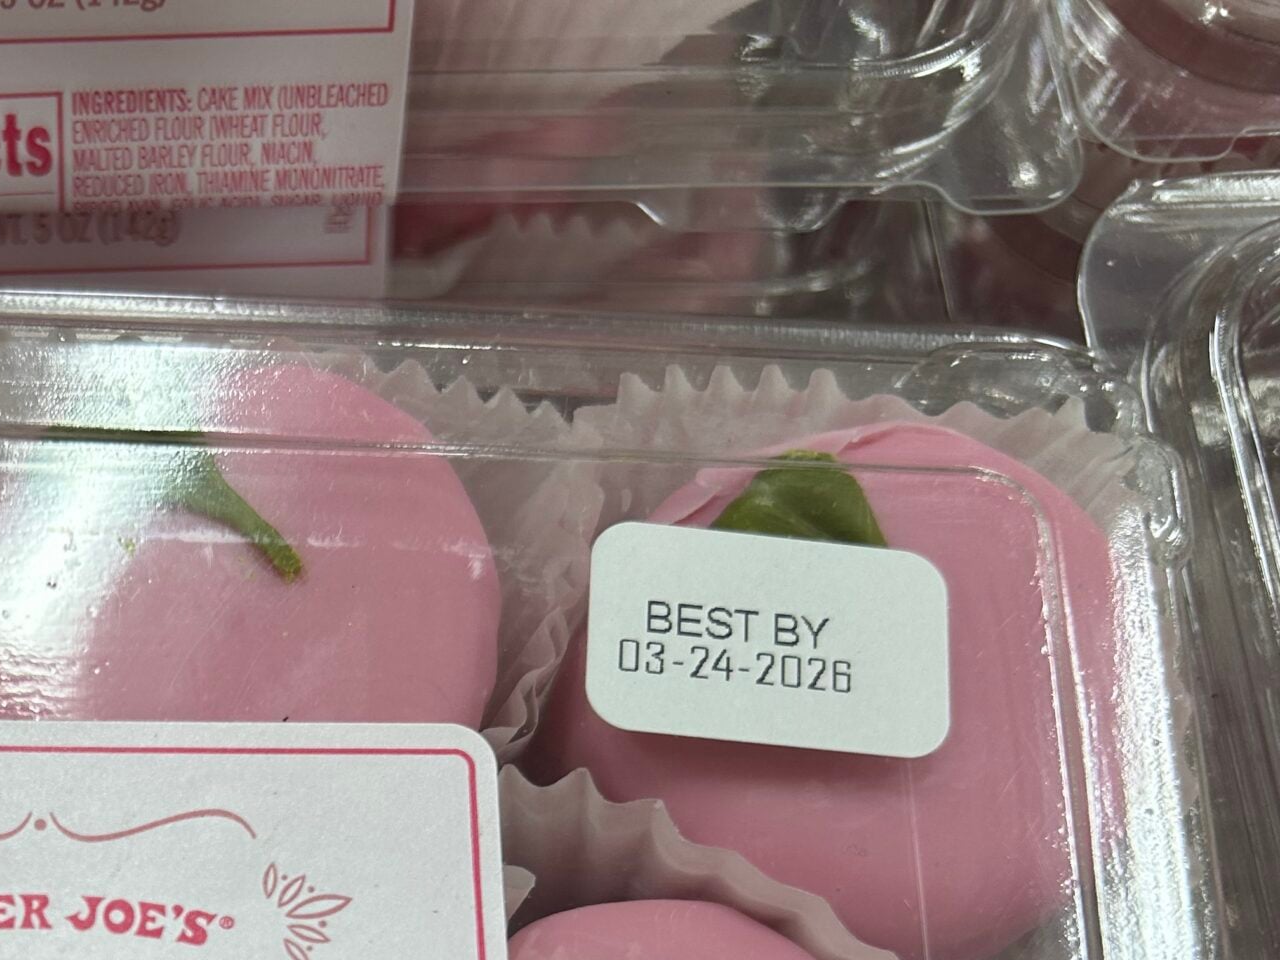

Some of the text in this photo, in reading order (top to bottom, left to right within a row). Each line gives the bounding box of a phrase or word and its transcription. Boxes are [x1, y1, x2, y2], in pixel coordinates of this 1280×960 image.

[71, 83, 390, 116] INGREDIENTS: CAKE MIX (UNBLEACHED
[72, 117, 150, 144] ENRICHED
[155, 116, 205, 142] FLOUR
[272, 112, 328, 140] FLOUR,
[73, 147, 133, 172] MALTED
[138, 145, 197, 170] BARLEY
[73, 174, 145, 198] REDUCED
[197, 169, 270, 194] THIAMINE
[647, 600, 830, 649] BEST BY
[618, 638, 852, 693] 03-24-2026
